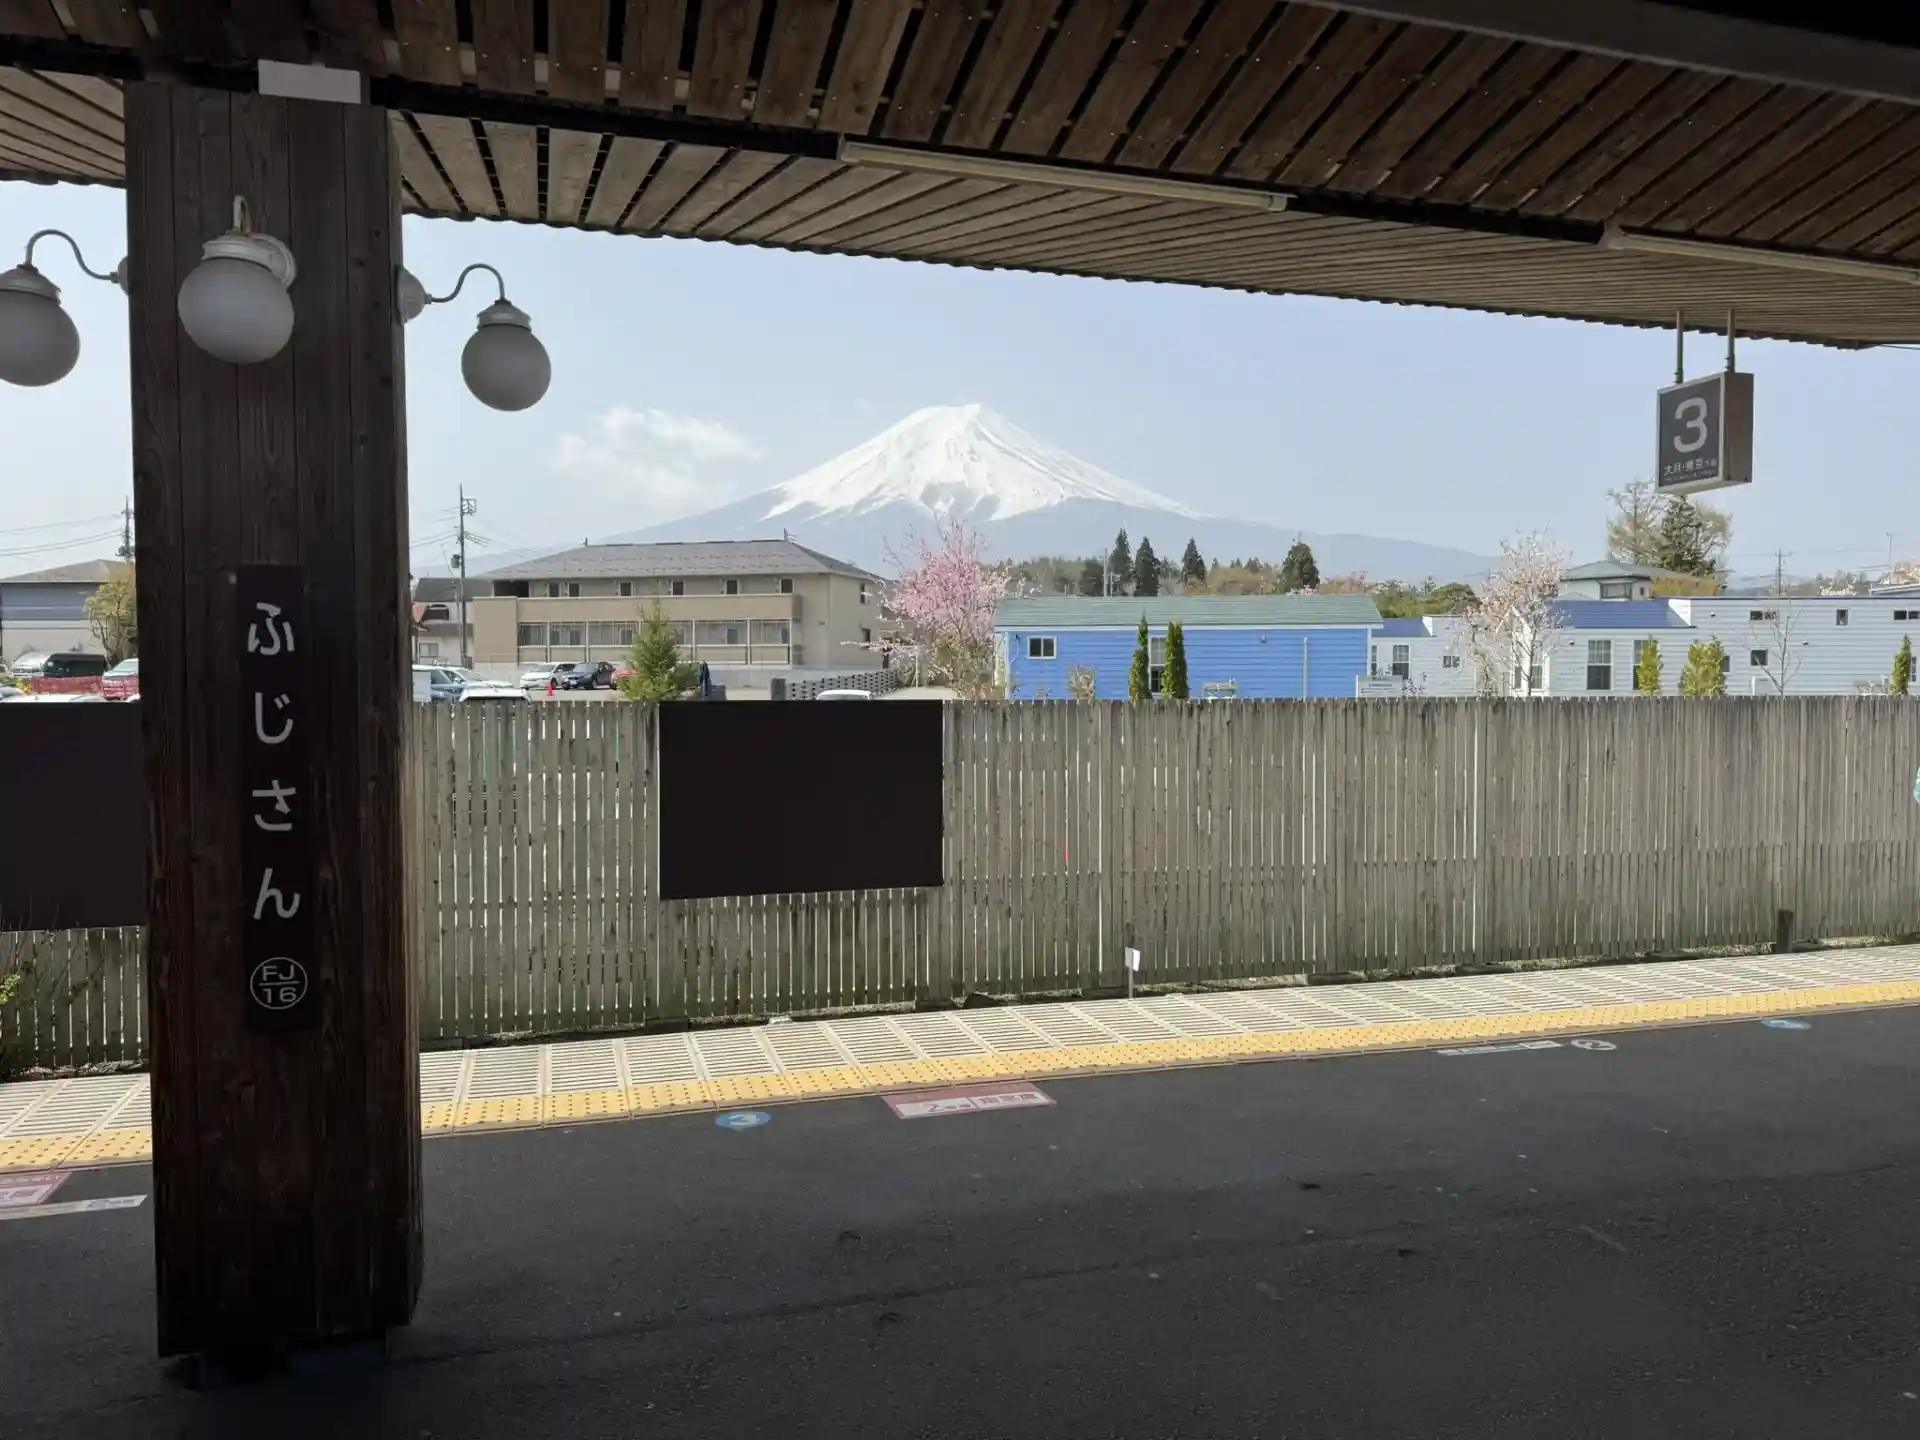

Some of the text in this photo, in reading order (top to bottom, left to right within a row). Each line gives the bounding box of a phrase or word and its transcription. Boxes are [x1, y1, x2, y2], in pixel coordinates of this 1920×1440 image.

[1673, 397, 1708, 453] 3
[247, 601, 301, 920] ふじさん
[262, 964, 295, 981] FJ
[262, 987, 297, 1004] 16
